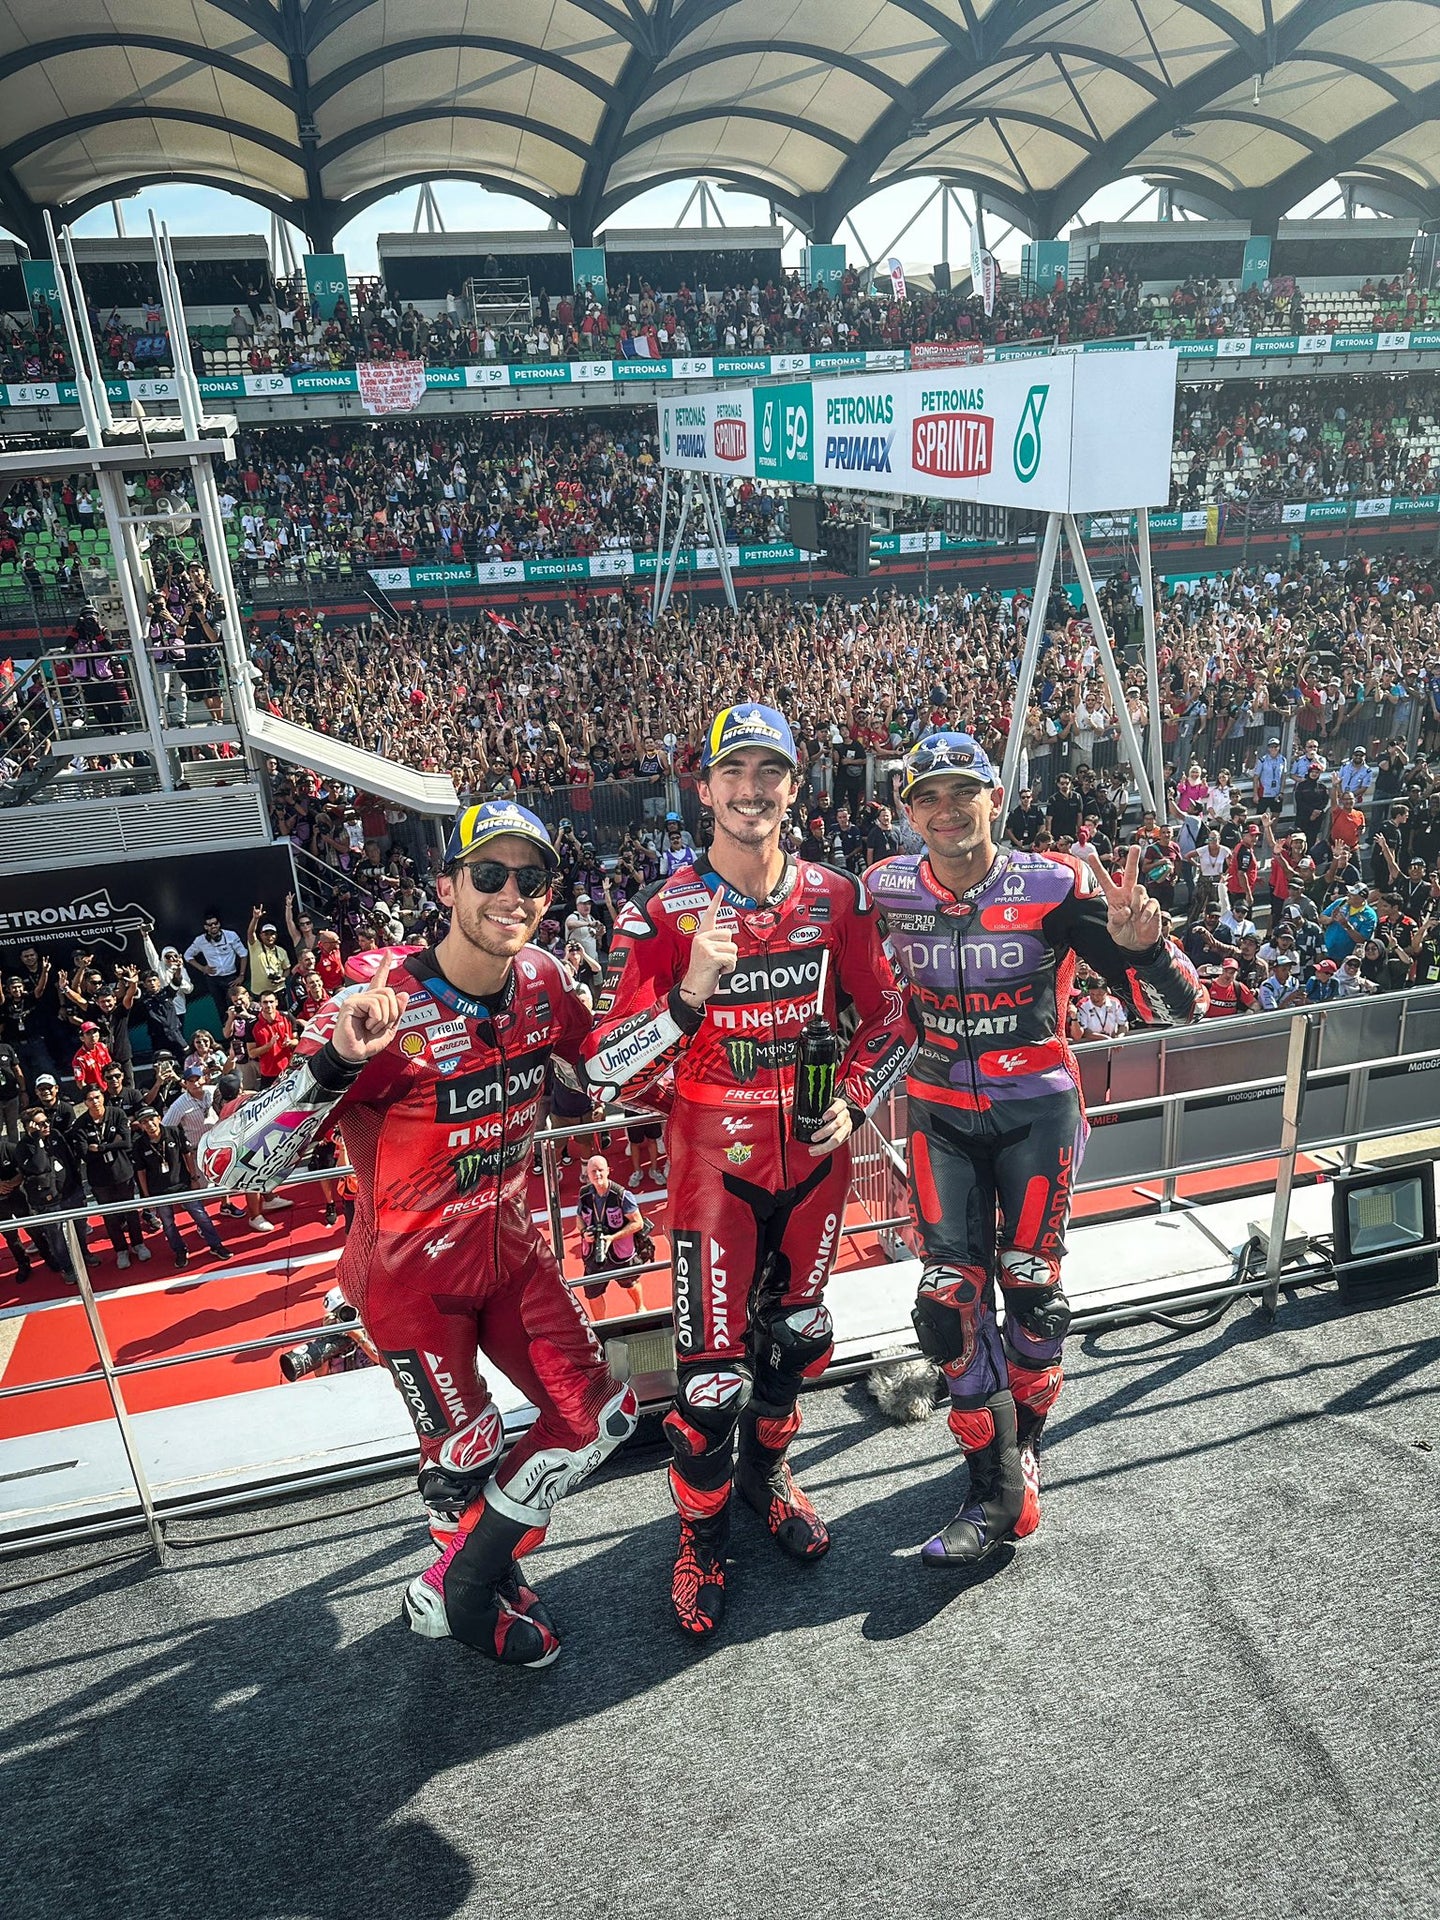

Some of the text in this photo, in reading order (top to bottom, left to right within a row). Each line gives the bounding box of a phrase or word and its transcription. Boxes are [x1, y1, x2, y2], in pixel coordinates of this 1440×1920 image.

[592, 275, 604, 286] 50
[830, 271, 842, 280] 50
[330, 282, 344, 294] 50
[1255, 341, 1295, 350] PETRONAS
[1316, 339, 1326, 348] 50
[1336, 338, 1374, 346] PETRONAS
[1394, 336, 1405, 344] 50
[1174, 344, 1214, 353] PETRONAS
[1236, 342, 1246, 350] 50
[694, 362, 706, 372] 50
[718, 362, 766, 371] PETRONAS
[792, 360, 804, 368] 50
[815, 357, 862, 368] PETRONAS
[490, 370, 502, 380] 50
[514, 368, 565, 378] PETRONAS
[594, 366, 606, 376] 50
[618, 365, 667, 374] PETRONAS
[297, 376, 351, 387] PETRONAS
[426, 373, 460, 382] RONAS
[154, 384, 168, 394] 50
[200, 382, 238, 392] TRONAS
[270, 379, 284, 390] 50
[35, 388, 50, 399] 50
[64, 387, 122, 398] PEAS
[921, 388, 984, 412] PETRONAS
[716, 404, 742, 418] PETRONAS
[826, 394, 893, 424] PETRONAS
[675, 406, 706, 426] PETRONAS
[786, 406, 808, 460] 50
[676, 434, 707, 458] PRIMAX
[716, 424, 744, 457] SPRINTA
[916, 420, 986, 472] SPRINTA
[824, 429, 896, 473] PRIMAX
[1374, 503, 1386, 512] 50
[1394, 501, 1434, 510] PETRONAS
[1290, 509, 1300, 517] 50
[1310, 507, 1347, 516] PETRONA
[1134, 518, 1178, 528] PRONAS
[744, 548, 794, 560] PETRONAS
[614, 560, 626, 570] 50
[640, 556, 689, 568] PETOAS
[504, 566, 516, 577] 50
[530, 563, 584, 574] PETRONAS
[388, 573, 402, 584] 50
[722, 725, 783, 742] MICHELIN
[476, 818, 542, 838] MICHELIN
[878, 874, 916, 890] FIAMM
[921, 865, 950, 900] PRAMAC
[804, 886, 830, 894] motorola
[668, 896, 706, 909] EATALY
[728, 890, 746, 906] TIM
[716, 907, 733, 918] ello
[914, 914, 936, 924] R10
[900, 923, 936, 932] HELMET
[16, 930, 80, 944] INTERNATIONAL
[81, 926, 114, 936] CIRCUIT
[790, 930, 820, 940] SUOMY
[903, 941, 1024, 977] prima
[714, 961, 820, 995] Lenovo
[526, 980, 545, 990] motorola
[910, 984, 1033, 1014] PRAMAC
[455, 998, 479, 1016] TIM
[534, 1002, 549, 1012] Lenovo
[400, 1009, 434, 1025] ATALY
[437, 1020, 464, 1035] riello
[606, 1014, 648, 1041] enovo
[922, 1011, 1018, 1037] DUCATI
[526, 1026, 550, 1045] KYT
[434, 1038, 470, 1053] CARRERA
[600, 1024, 662, 1071] UnipolSai
[756, 1042, 798, 1056] MONS
[768, 1054, 796, 1064] ENER
[918, 1046, 950, 1063] GAS
[438, 1060, 458, 1074] SAP
[868, 1046, 905, 1086] Lenovo
[450, 1064, 545, 1115] Lenovo
[724, 1086, 794, 1100] FRECCIAR
[1227, 1085, 1285, 1102] motogppremie
[798, 1115, 828, 1125] MONS
[1089, 1114, 1118, 1126] EMIER
[1041, 1146, 1073, 1254] RAMAC
[808, 1213, 836, 1285] DAIKO
[676, 1240, 693, 1348] Lenovo
